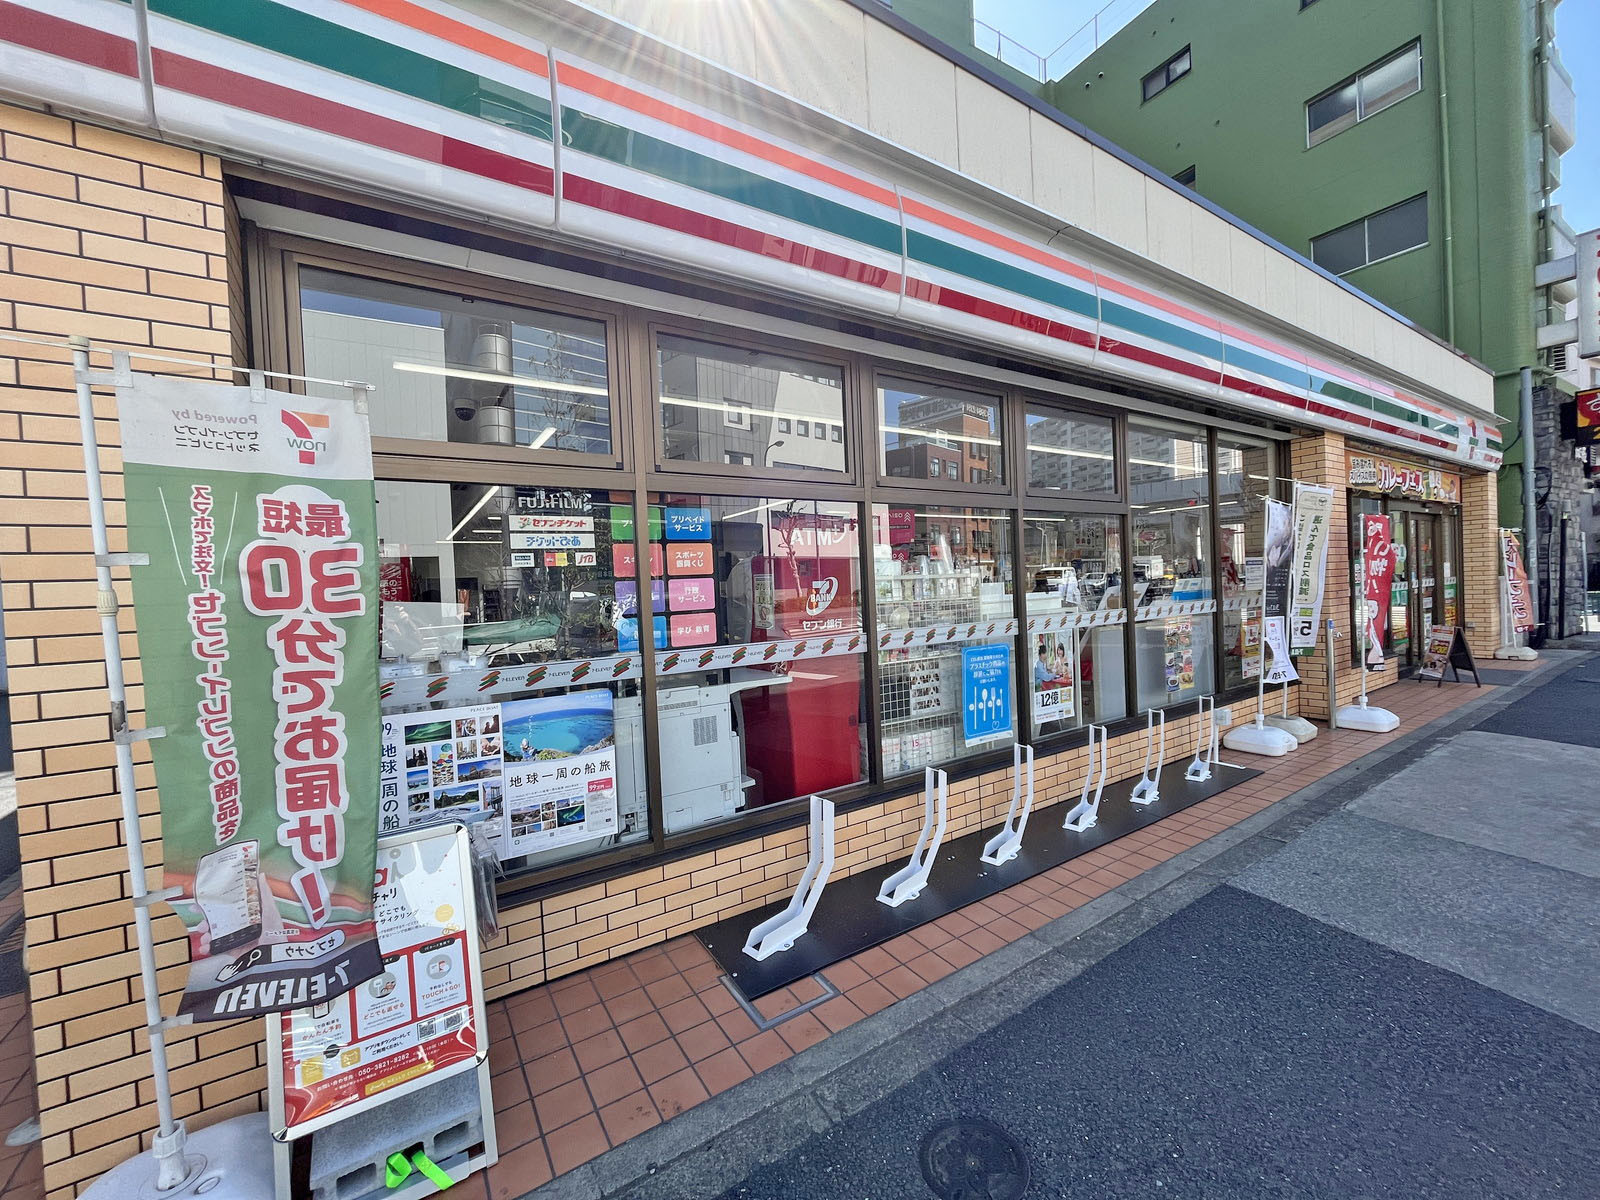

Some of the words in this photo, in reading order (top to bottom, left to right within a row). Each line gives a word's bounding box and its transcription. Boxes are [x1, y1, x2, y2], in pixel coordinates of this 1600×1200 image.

[1378, 460, 1424, 494] カレーフェス
[518, 497, 582, 509] FUJIFILM
[532, 517, 587, 528] セブンチケット
[674, 523, 703, 532] サービス
[577, 554, 594, 564] JTB
[802, 618, 843, 630] セブン銀行
[509, 759, 612, 788] 地球一周の船旅
